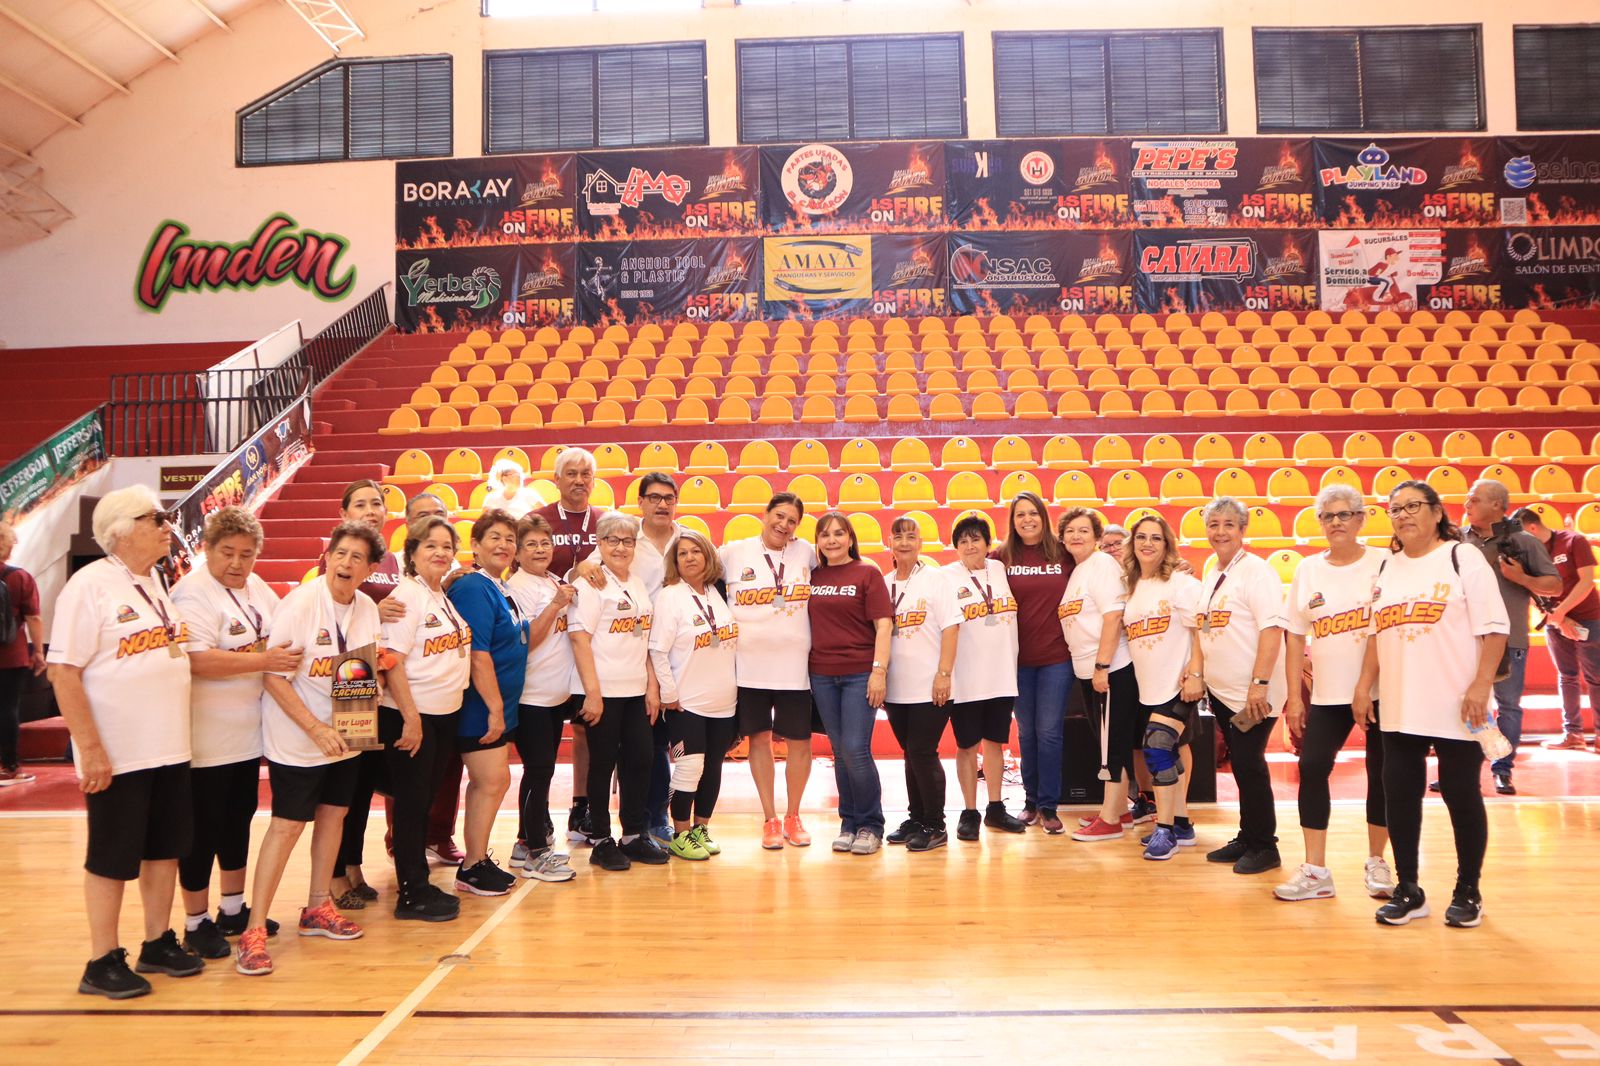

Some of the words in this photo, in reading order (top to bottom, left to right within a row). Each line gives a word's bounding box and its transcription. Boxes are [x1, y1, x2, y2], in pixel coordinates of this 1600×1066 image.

[786, 150, 814, 174] PARTES
[815, 149, 848, 172] USADAS
[1134, 147, 1238, 170] PEPE'S
[1186, 179, 1220, 189] SONORA
[1320, 165, 1427, 187] PLAYLAND
[1348, 181, 1380, 189] JUMPING
[1380, 181, 1400, 189] PARK
[404, 178, 512, 202] BORAKAY
[418, 198, 501, 207] RESTAURANT
[685, 216, 708, 227] ON
[708, 200, 757, 223] FIRE
[871, 210, 895, 222] ON
[894, 196, 942, 219] FIRE
[1057, 207, 1081, 218] ON
[1080, 194, 1128, 218] FIRE
[1242, 206, 1264, 217] ON
[1265, 193, 1312, 216] FIRE
[1424, 206, 1446, 217] ON
[1446, 193, 1495, 216] FIRE
[503, 222, 526, 234] ON
[526, 208, 574, 231] FIRE
[1364, 235, 1408, 245] SUCURSALES
[620, 257, 671, 271] ANCHOR
[675, 256, 706, 270] TOOL
[780, 252, 856, 270] AMAYA
[1140, 245, 1251, 273] CAVARA
[1515, 264, 1550, 275] SALÓN
[1552, 265, 1567, 274] DE
[633, 270, 686, 284] PLASTIC
[776, 271, 818, 279] MANGUERAS
[1325, 267, 1360, 276] Servicio
[1326, 276, 1367, 285] Domicilio
[400, 273, 486, 307] Yerbas
[417, 291, 477, 304] Medicinales
[873, 302, 897, 314] ON
[896, 288, 944, 312] FIRE
[1060, 299, 1083, 311] ON
[1083, 285, 1132, 309] FIRE
[1245, 298, 1268, 309] ON
[1268, 284, 1316, 307] FIRE
[1430, 298, 1453, 309] ON
[1453, 284, 1501, 308] FIRE
[503, 312, 526, 324] ON
[526, 298, 574, 321] FIRE
[686, 307, 710, 318] ON
[709, 293, 758, 316] FIRE
[52, 419, 102, 464] JEFFERSON
[0, 453, 50, 504] JEFFERSON
[331, 687, 377, 697] CACHIBOL
[336, 719, 349, 727] 1er
[350, 718, 373, 727] Lugar
